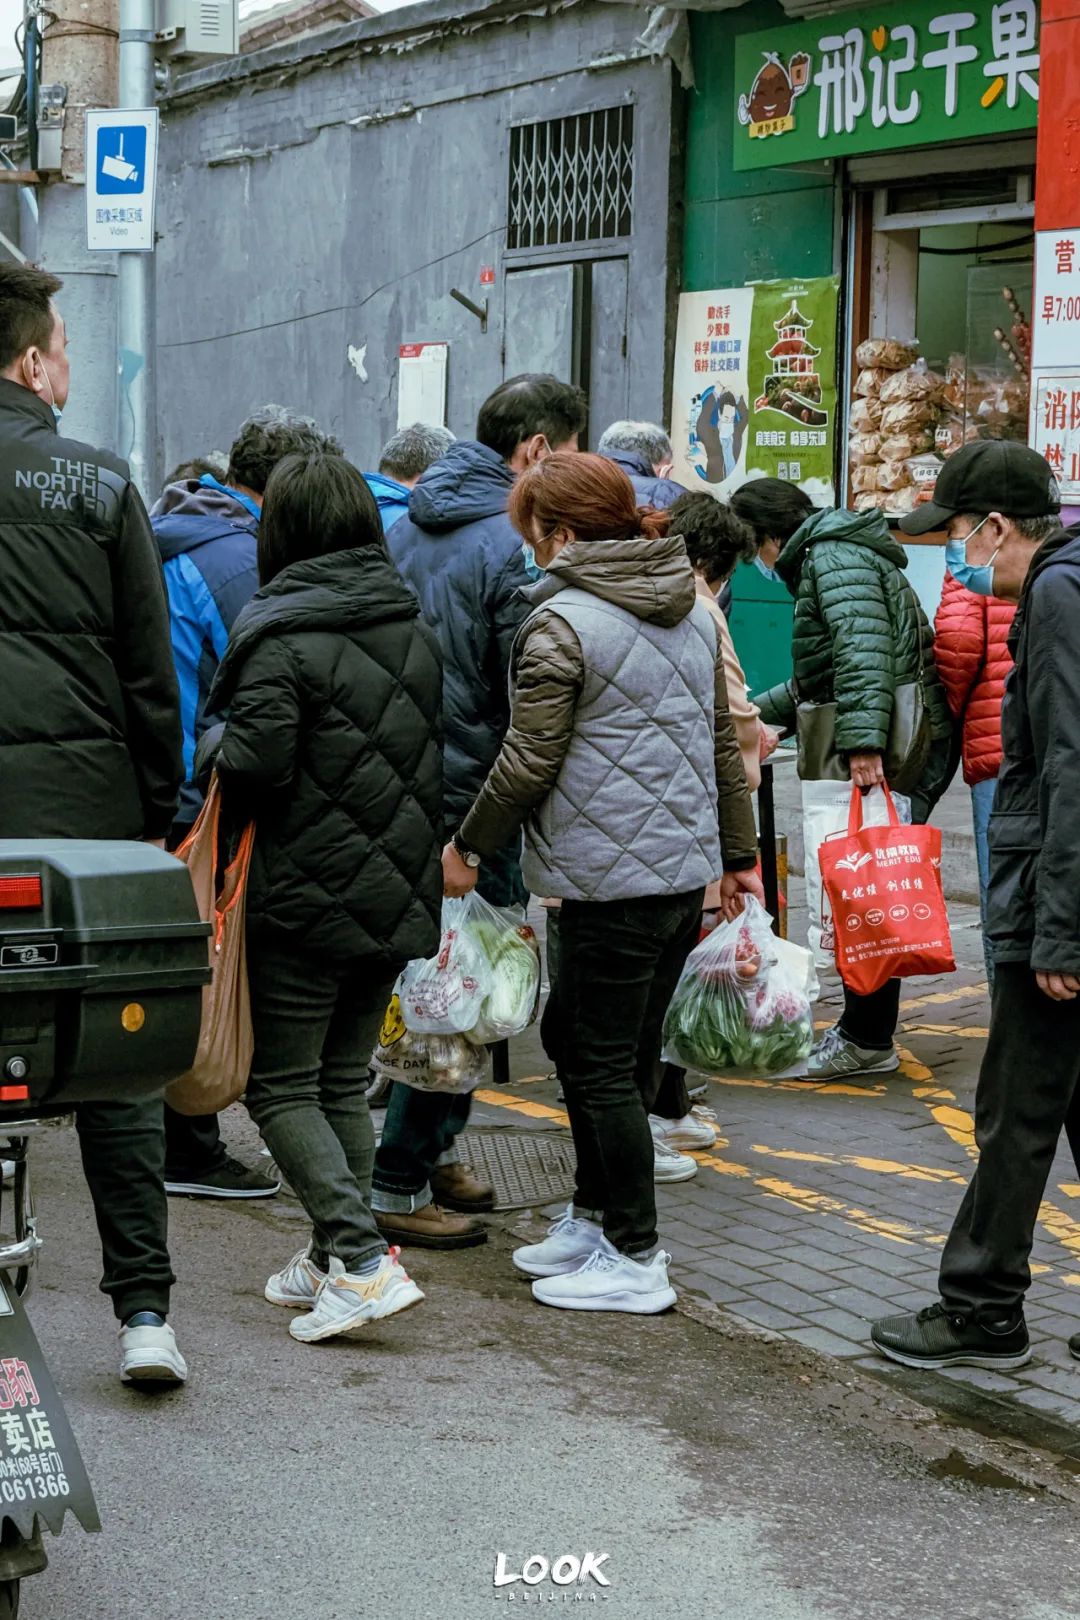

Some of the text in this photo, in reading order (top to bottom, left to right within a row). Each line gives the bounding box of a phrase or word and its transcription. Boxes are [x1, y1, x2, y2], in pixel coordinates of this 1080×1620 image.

[96, 208, 143, 223] 图像采集区域
[109, 226, 129, 236] Video
[1055, 240, 1080, 275] 营
[693, 358, 741, 373] 保持社交距离
[50, 457, 97, 479] THE
[15, 470, 97, 497] NORTH
[0, 1408, 56, 1456] 卖店
